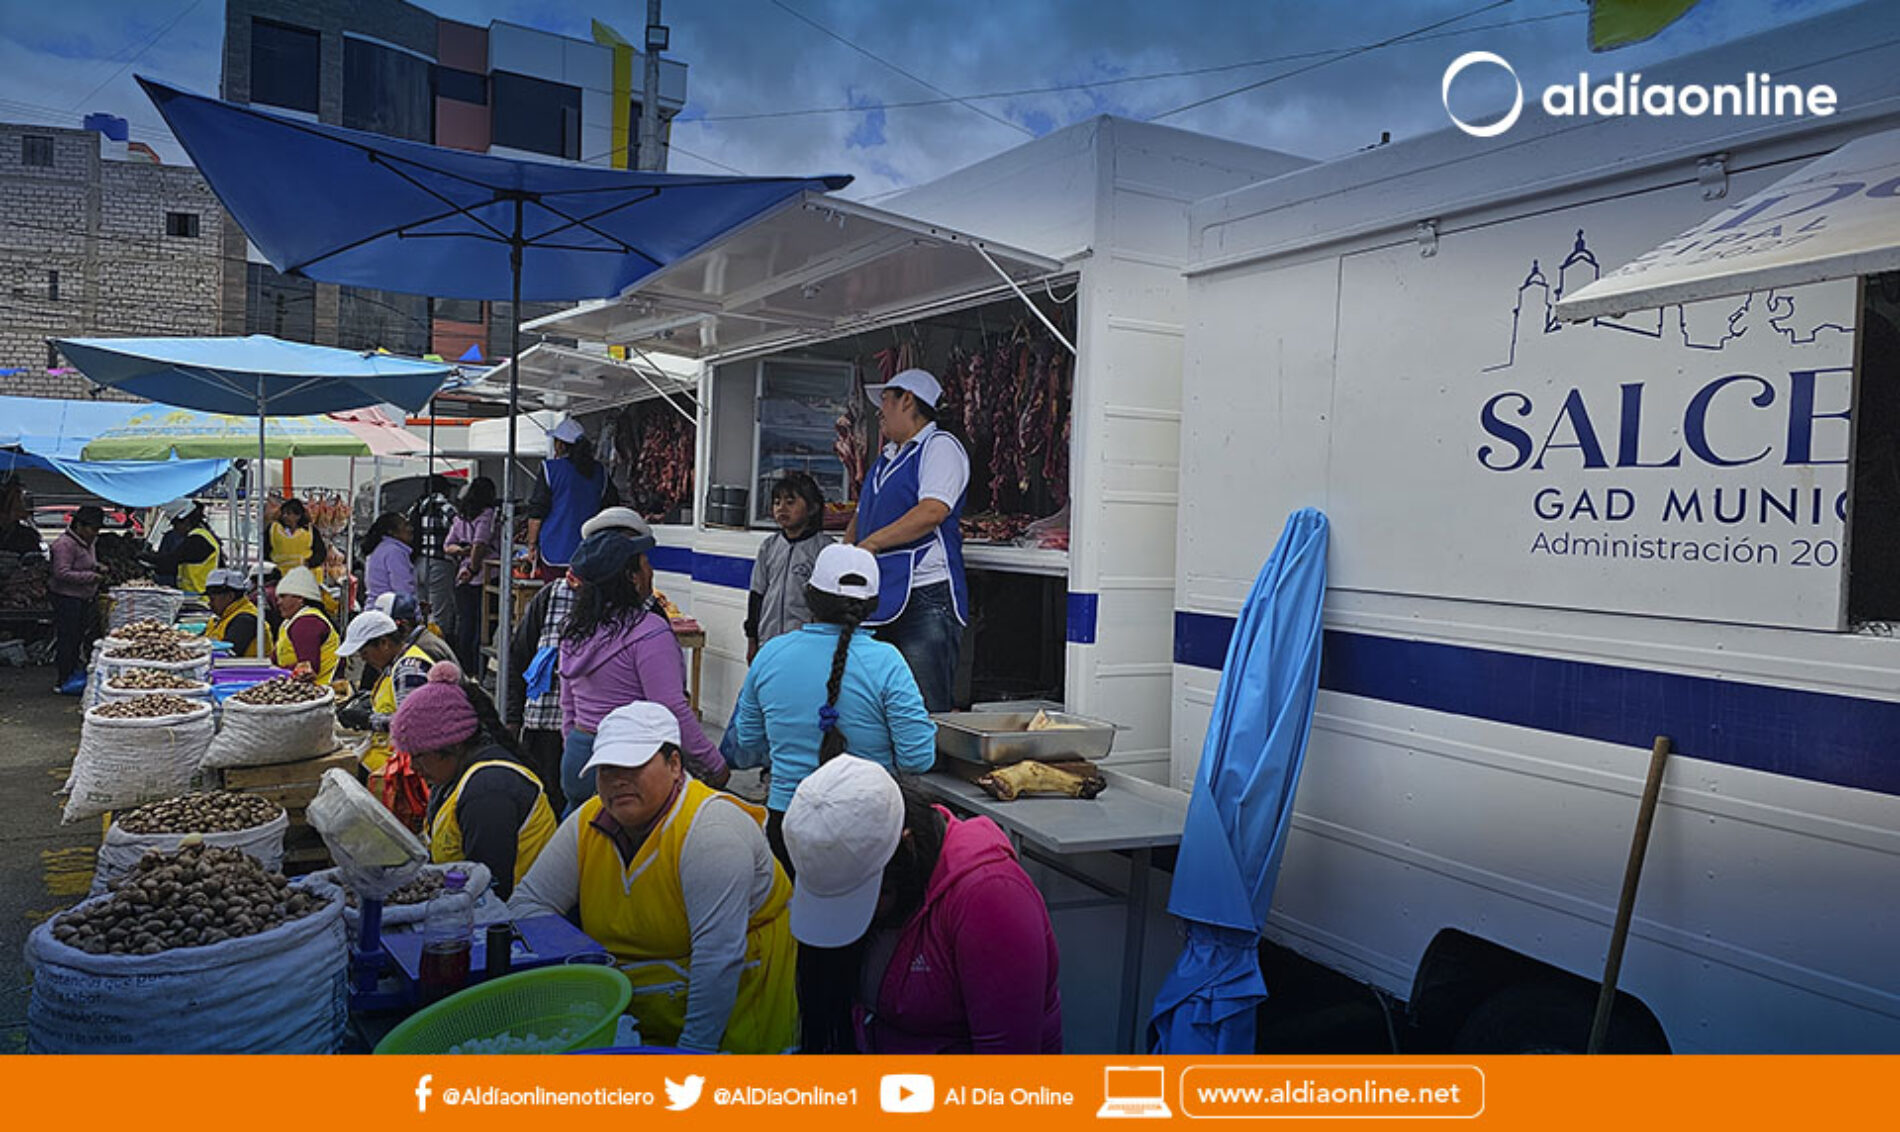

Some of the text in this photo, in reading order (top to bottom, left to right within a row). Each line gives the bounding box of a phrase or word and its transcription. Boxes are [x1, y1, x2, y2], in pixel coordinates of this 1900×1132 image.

[1533, 488, 1636, 521] GAD
[1531, 532, 1838, 567] Administración 20
